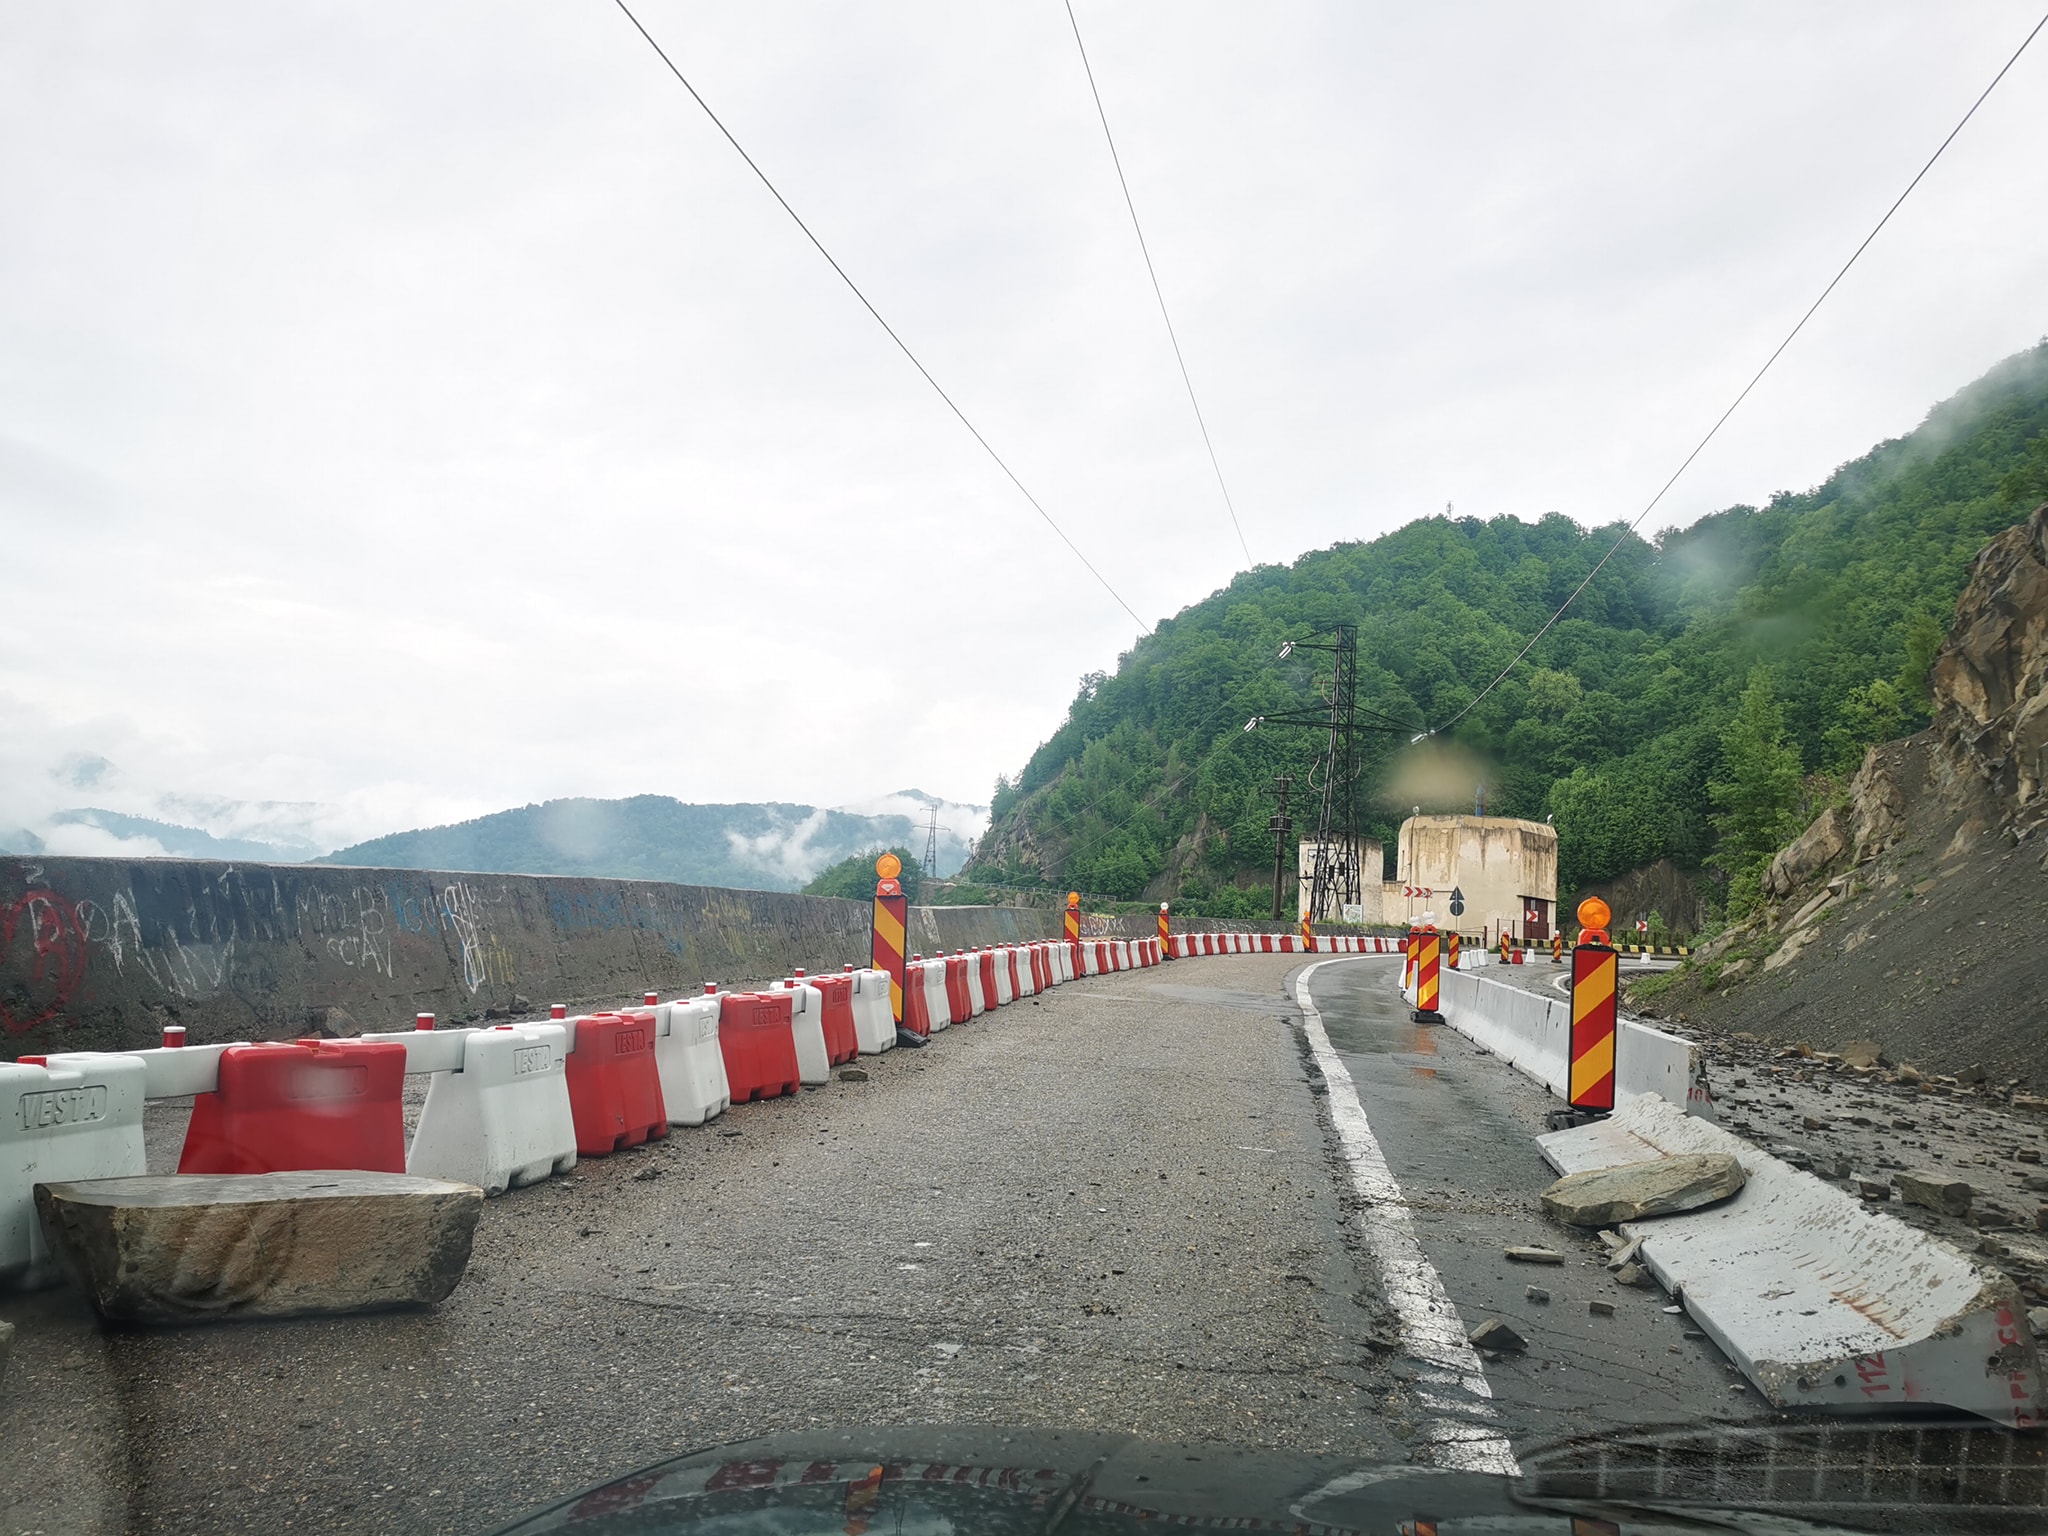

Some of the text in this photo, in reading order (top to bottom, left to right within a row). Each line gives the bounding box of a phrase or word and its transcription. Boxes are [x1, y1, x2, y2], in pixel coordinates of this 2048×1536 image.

[615, 1031, 644, 1054] VESTA
[514, 1047, 549, 1075] VESTA
[22, 1088, 101, 1130] VESTA
[1853, 1352, 1891, 1398] 112
